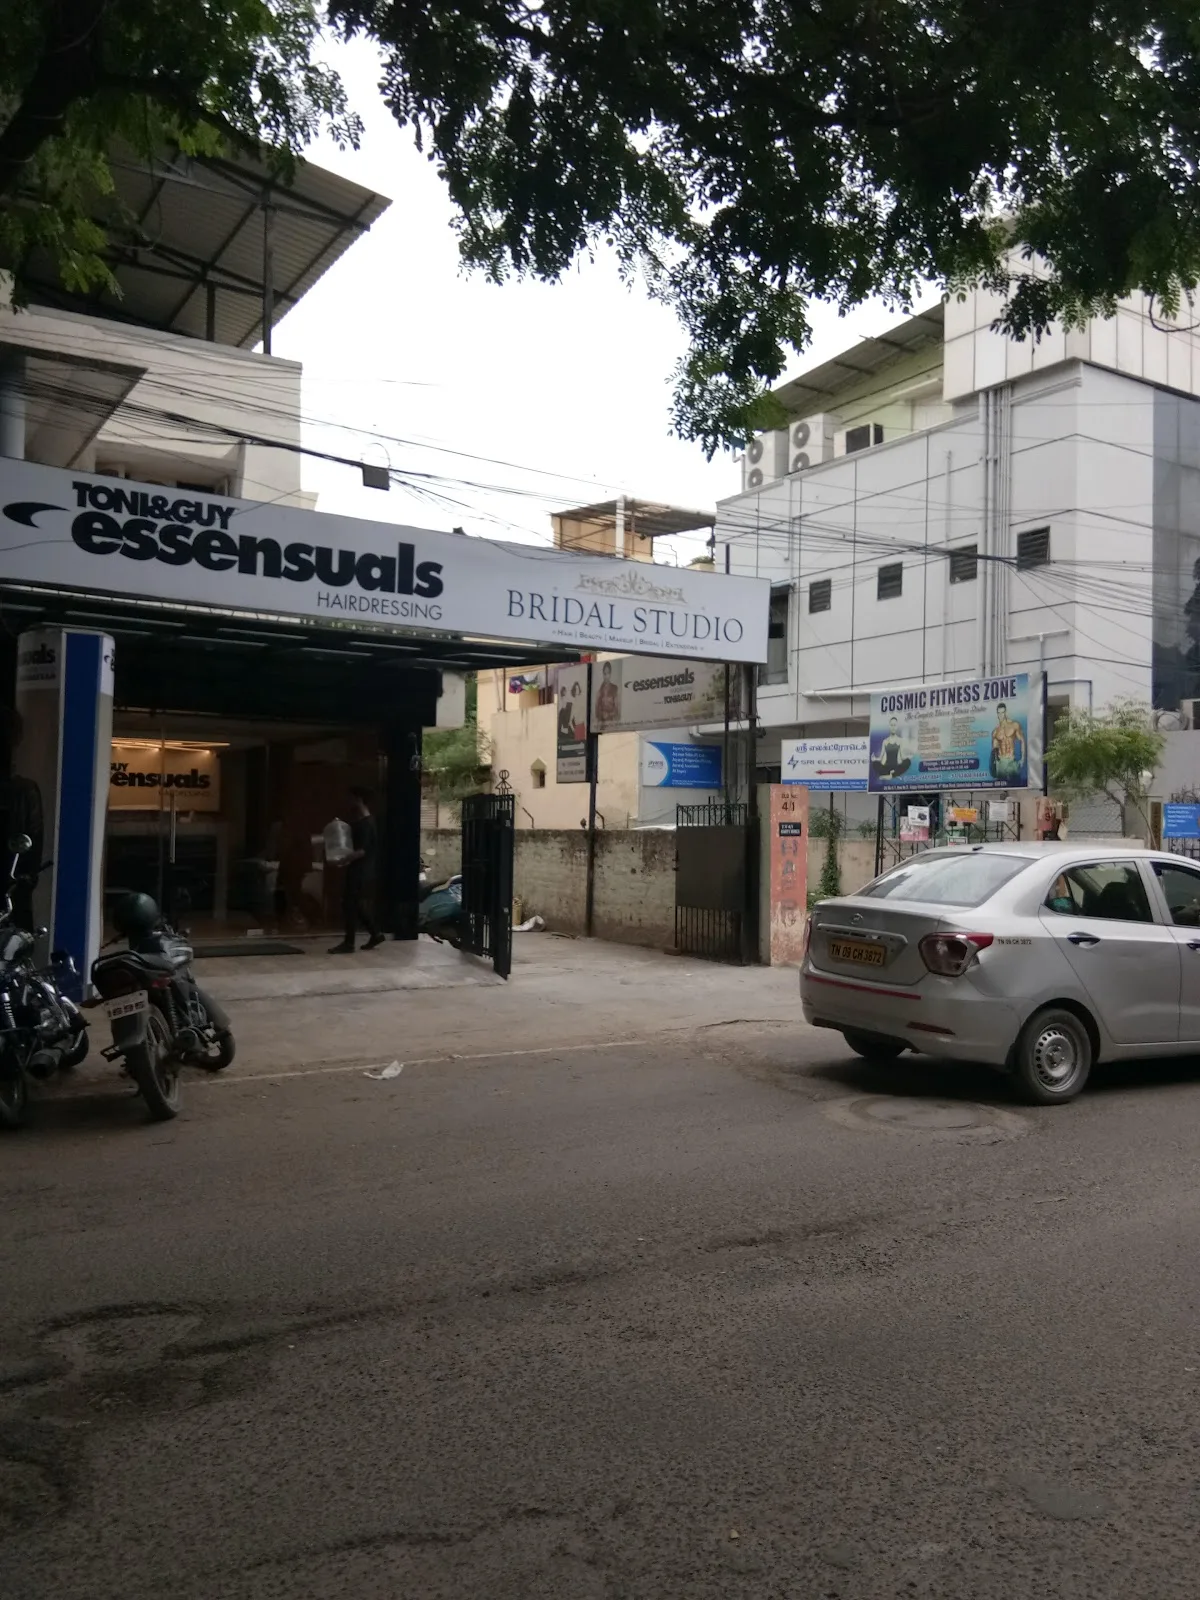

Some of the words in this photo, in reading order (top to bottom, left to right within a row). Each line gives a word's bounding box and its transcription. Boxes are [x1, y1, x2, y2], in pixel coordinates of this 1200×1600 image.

[72, 480, 236, 530] TONI&GUY
[71, 511, 444, 598] essensuals
[317, 591, 443, 621] HAIRDRESSING
[507, 589, 623, 630] BRIDAL
[633, 607, 744, 643] STUDIO
[632, 668, 695, 692] essensuals
[881, 691, 927, 713] COSMIC
[930, 683, 980, 707] FITNESS
[984, 679, 1017, 701] ZONE
[831, 944, 841, 956] TN
[853, 948, 863, 960] CH
